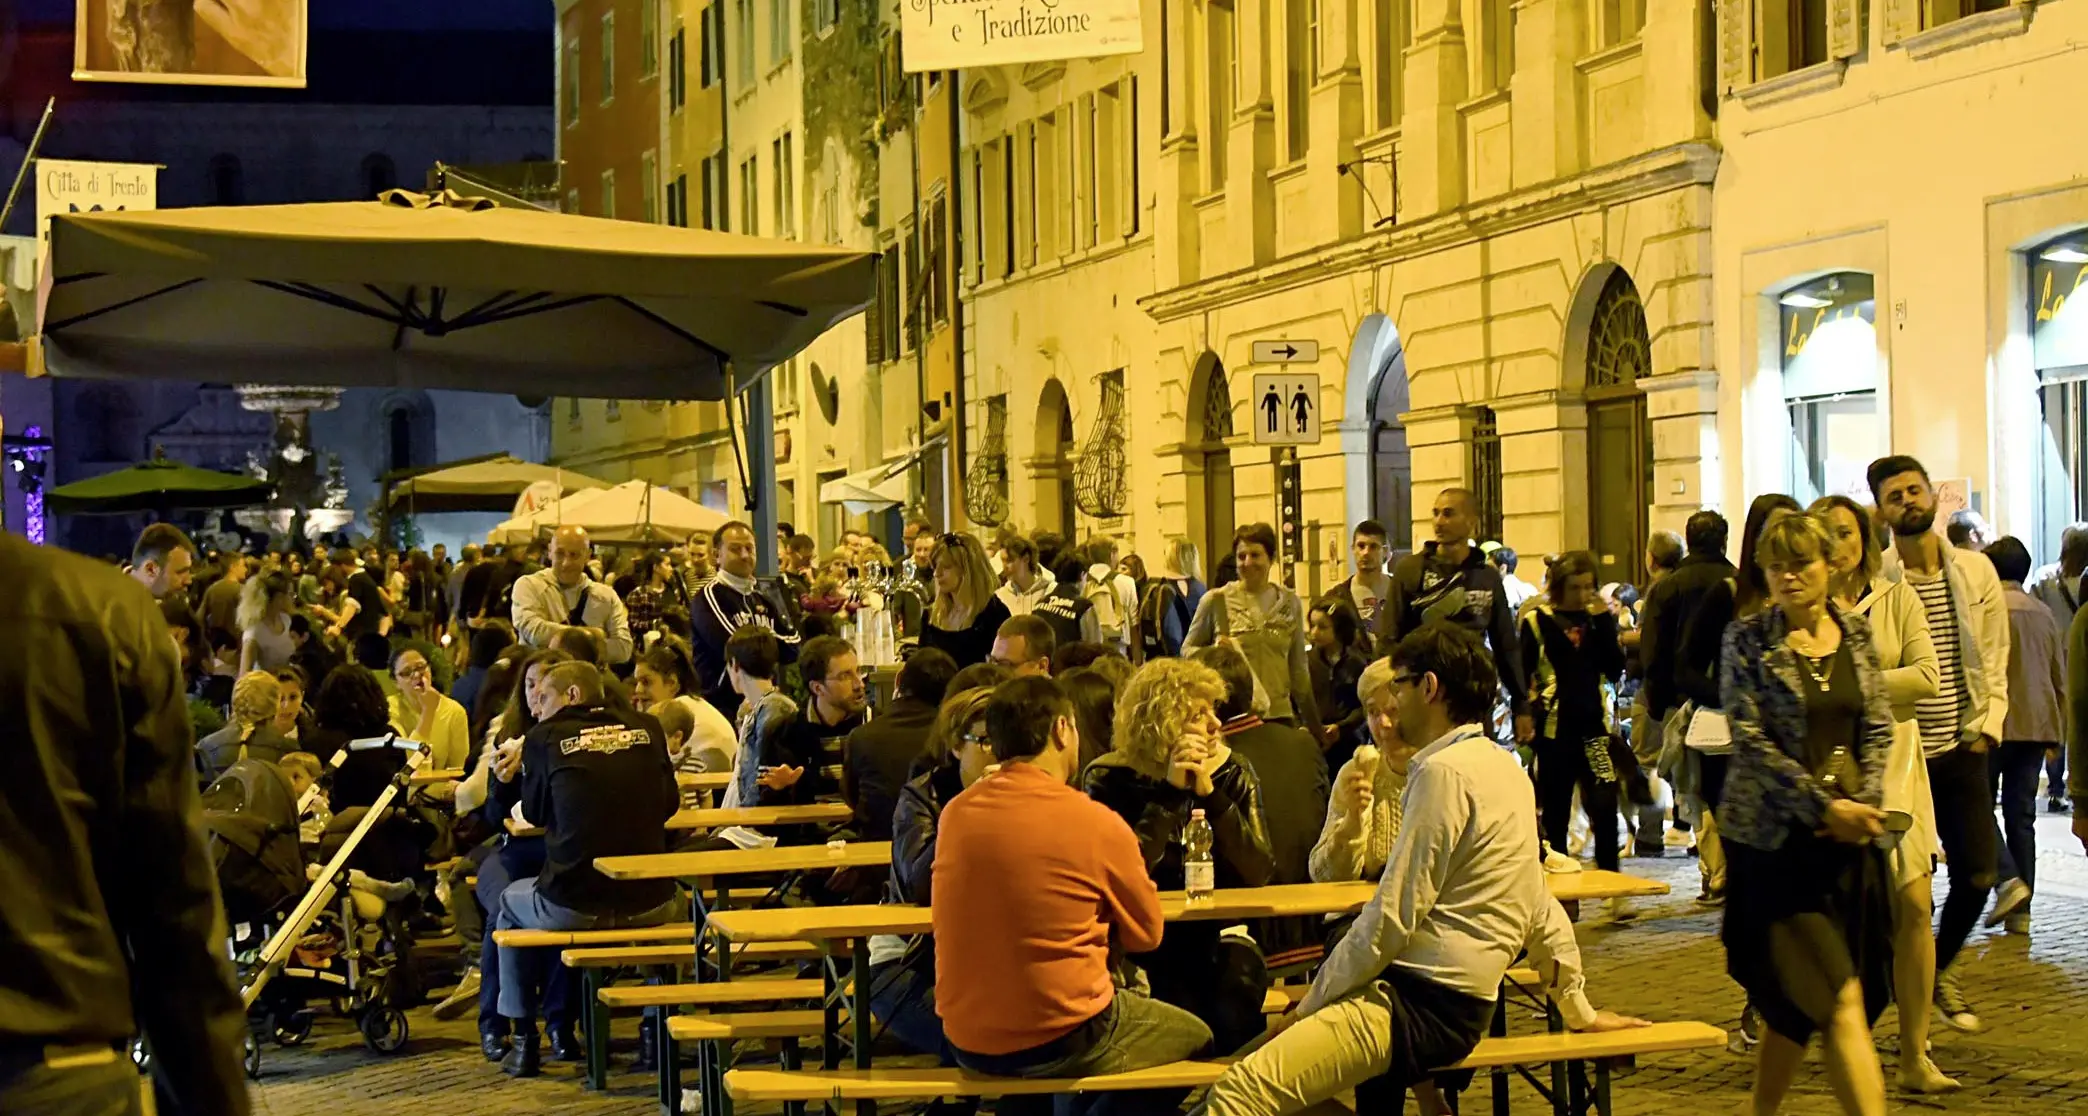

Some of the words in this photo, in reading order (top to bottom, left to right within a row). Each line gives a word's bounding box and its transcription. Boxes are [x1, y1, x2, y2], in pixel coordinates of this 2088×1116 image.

[951, 22, 963, 43] e
[975, 6, 1091, 46] Tradizione
[87, 171, 99, 193] di
[107, 171, 148, 197] Trento
